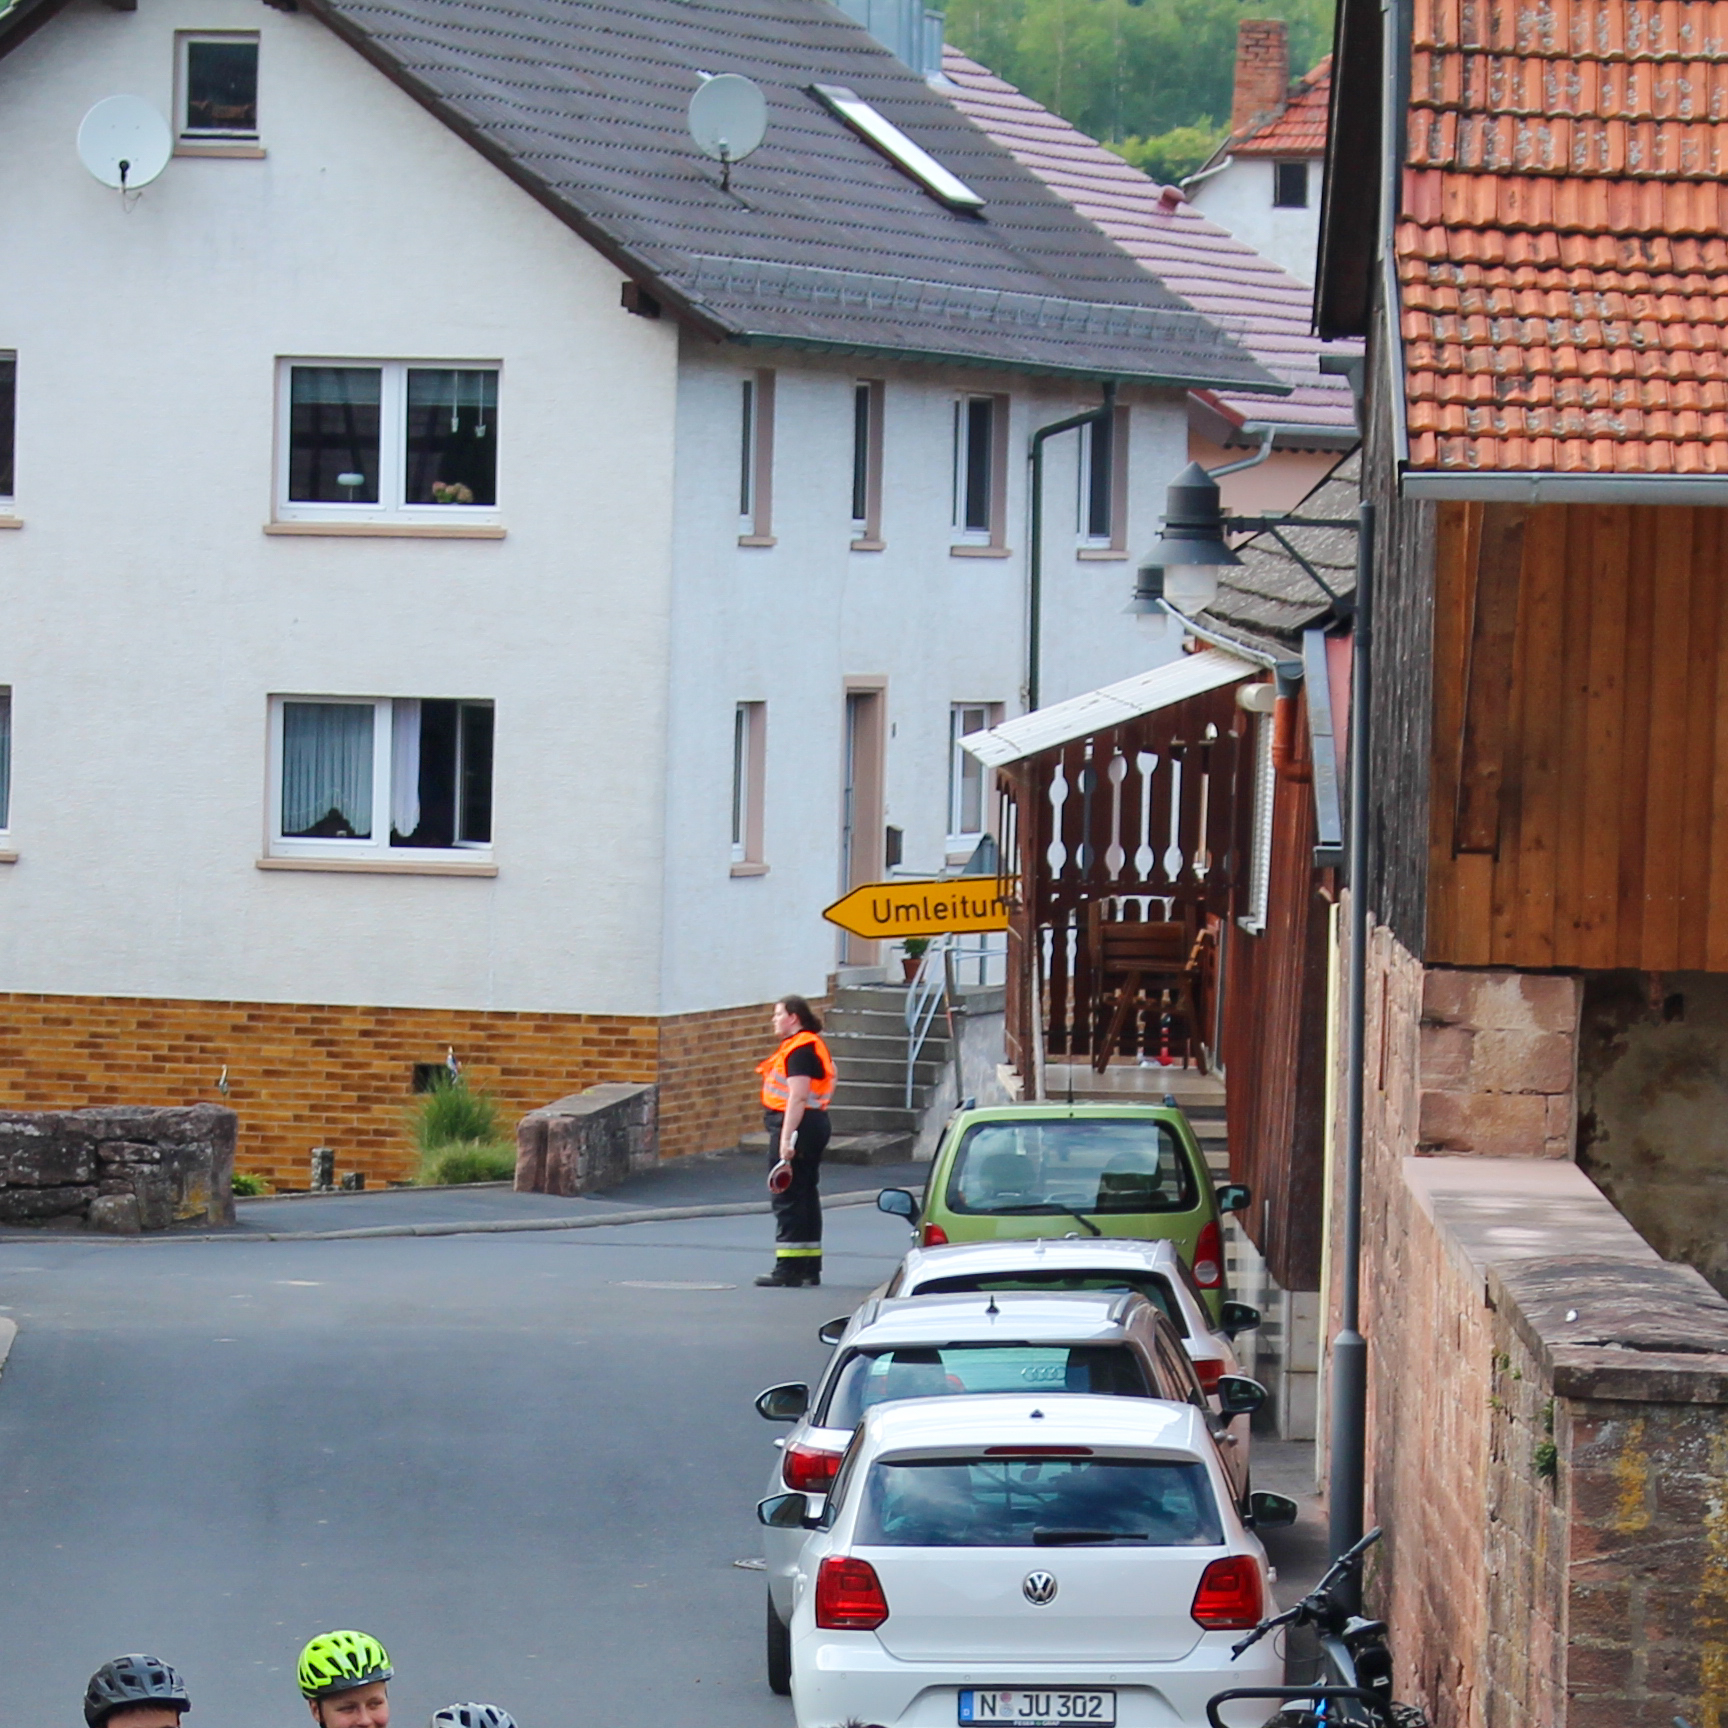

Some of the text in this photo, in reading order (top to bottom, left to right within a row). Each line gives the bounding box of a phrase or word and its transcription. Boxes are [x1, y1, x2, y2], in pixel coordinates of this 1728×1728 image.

[872, 894, 1007, 924] Umleitun
[981, 1693, 997, 1717] N
[1018, 1693, 1051, 1718] JU
[1057, 1694, 1103, 1718] 302
